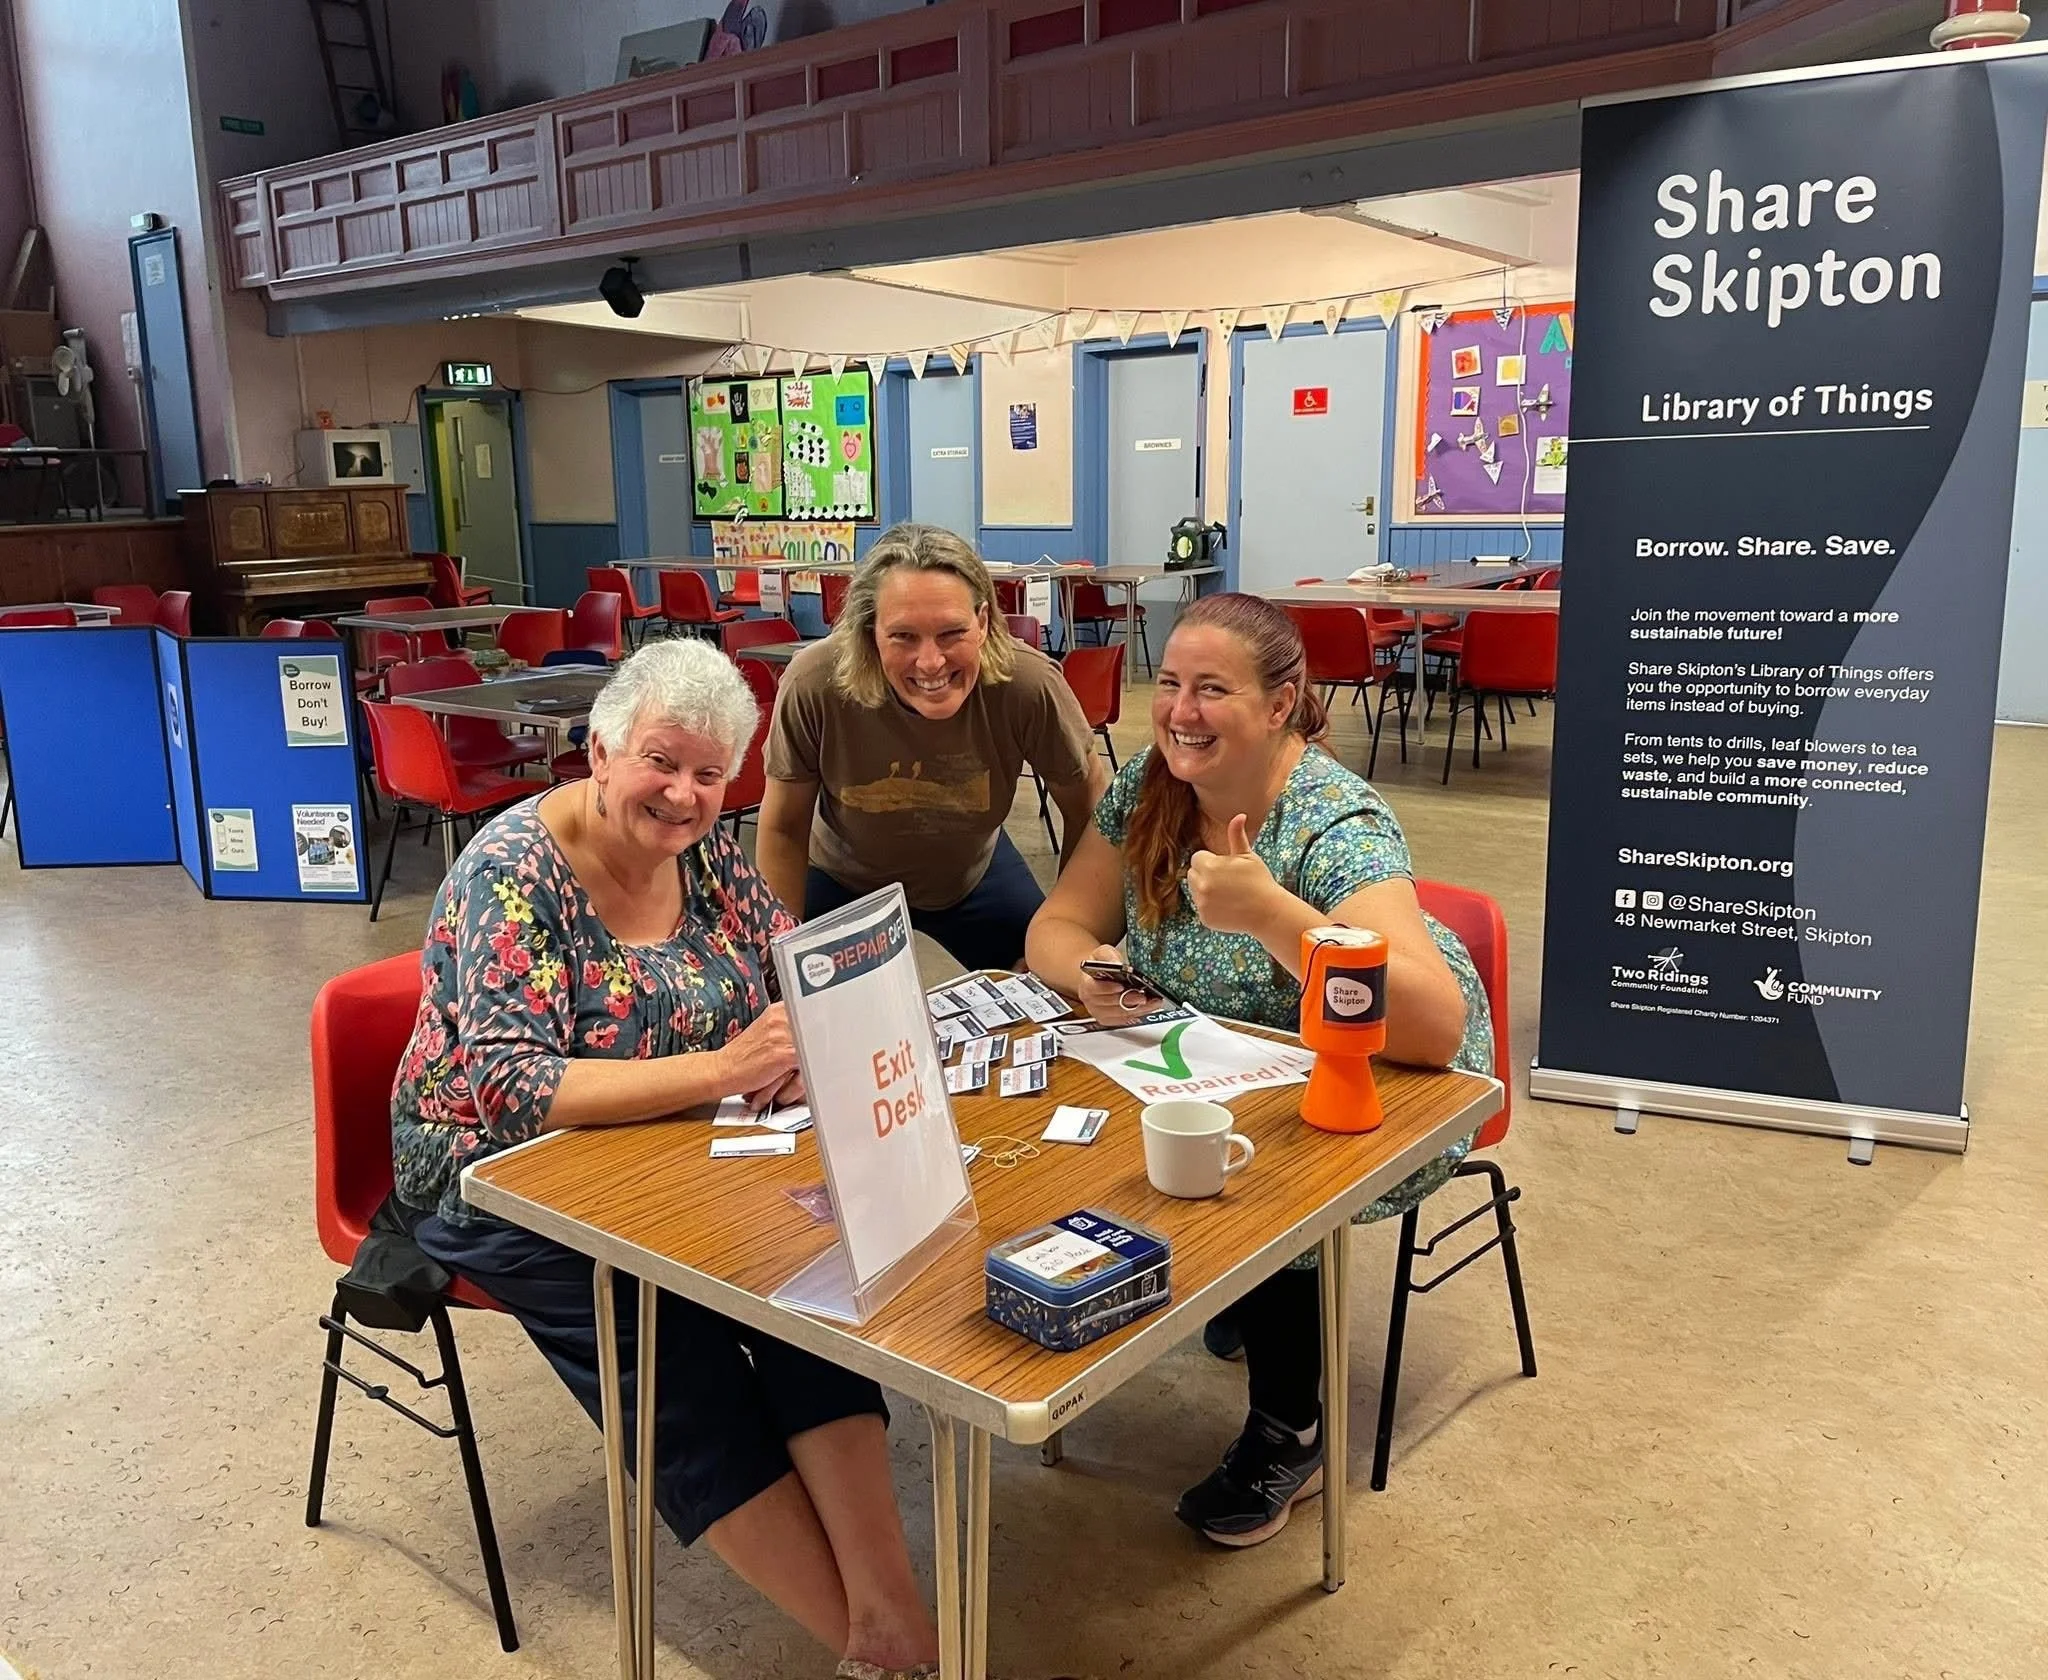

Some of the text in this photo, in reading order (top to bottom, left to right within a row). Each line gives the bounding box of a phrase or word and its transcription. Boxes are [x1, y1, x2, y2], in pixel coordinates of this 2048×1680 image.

[1653, 168, 1877, 239] Share
[1649, 248, 1942, 328] Skipton
[1642, 384, 1933, 425] Library of Things
[1636, 536, 1896, 557] Borrow. Share. Save.
[1631, 609, 1899, 623] Join the movement toward a more
[1630, 627, 1782, 640] sustainable future!
[1628, 663, 1672, 676] Share
[1751, 664, 1804, 680] Library
[1808, 665, 1824, 678] of
[1828, 665, 1883, 682] Things
[1887, 667, 1934, 680] offers
[290, 680, 331, 690] Borrow
[1627, 681, 1929, 702] you the opportunity to borrow everyday
[298, 698, 328, 708] Don't
[1626, 699, 1803, 716] items instead of buying.
[302, 716, 328, 728] Buy!
[1625, 733, 1917, 756] From tents to drills, leaf blowers to tea
[1623, 753, 1928, 776] sets, we help you save money, reduce
[1622, 770, 1906, 795] waste, and build a more connected,
[1621, 786, 1813, 808] sustainable community.
[296, 810, 336, 818] Volunteers
[1619, 848, 1793, 877] ShareSkipton.org
[1668, 895, 1816, 921] @ShareSkipton
[1615, 913, 1872, 946] 48 Newmarket Street, Skipton
[832, 932, 887, 969] REPAIR
[1612, 966, 1708, 985] Two Ridings
[1334, 987, 1358, 995] Share
[1611, 980, 1708, 994] Community Foundation
[1788, 982, 1882, 1000] COMMUNITY
[1334, 996, 1365, 1005] Skipton
[1787, 993, 1824, 1005] FUND
[1632, 1004, 1655, 1012] Skipton
[1657, 1006, 1692, 1015] Registered
[1694, 1010, 1718, 1019] Charity
[872, 1039, 915, 1090] Exit
[873, 1074, 926, 1138] Desk
[1052, 1392, 1084, 1420] GOPAK
